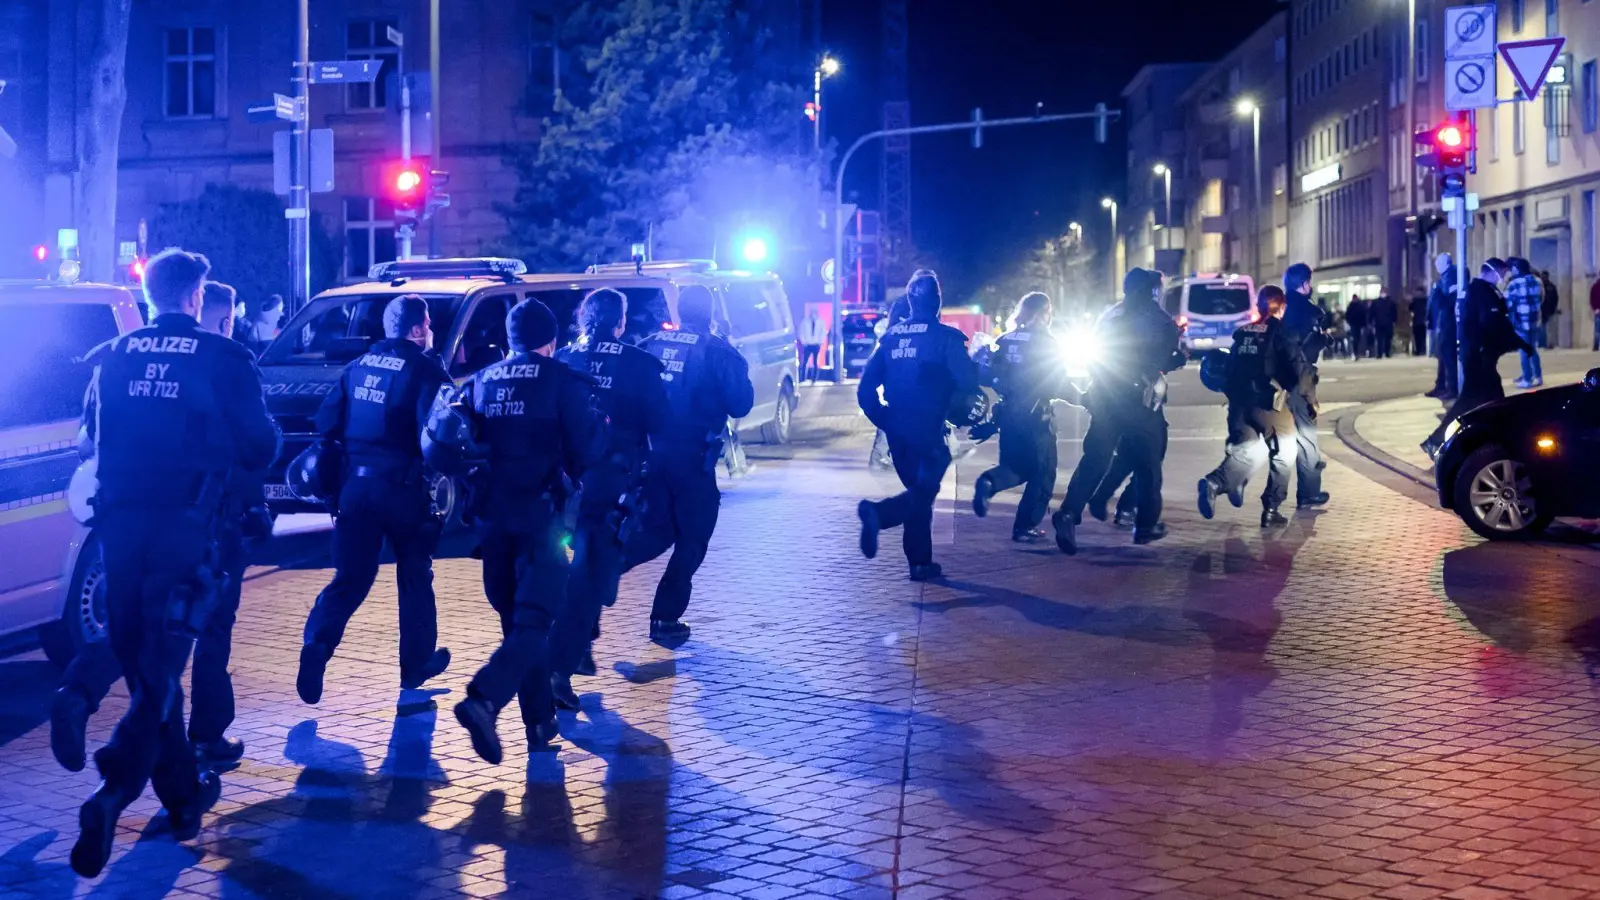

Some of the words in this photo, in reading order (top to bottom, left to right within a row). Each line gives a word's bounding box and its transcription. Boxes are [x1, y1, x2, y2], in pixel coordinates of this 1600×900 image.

[891, 323, 928, 335] POLIZEI
[126, 336, 198, 353] POLIZEI
[655, 331, 699, 344] POLIZEI
[899, 338, 911, 348] BY
[570, 342, 623, 354] POIZEI
[662, 348, 679, 359] BY
[359, 354, 405, 371] POLIZEI
[145, 363, 170, 379] BY
[482, 364, 540, 383] POLIZEI
[364, 374, 381, 388] BY
[129, 380, 152, 396] UFR
[153, 381, 179, 398] 7122
[261, 382, 335, 395] POLIZEI
[496, 386, 515, 401] BY
[485, 403, 502, 418] UFR
[504, 400, 524, 415] 7122
